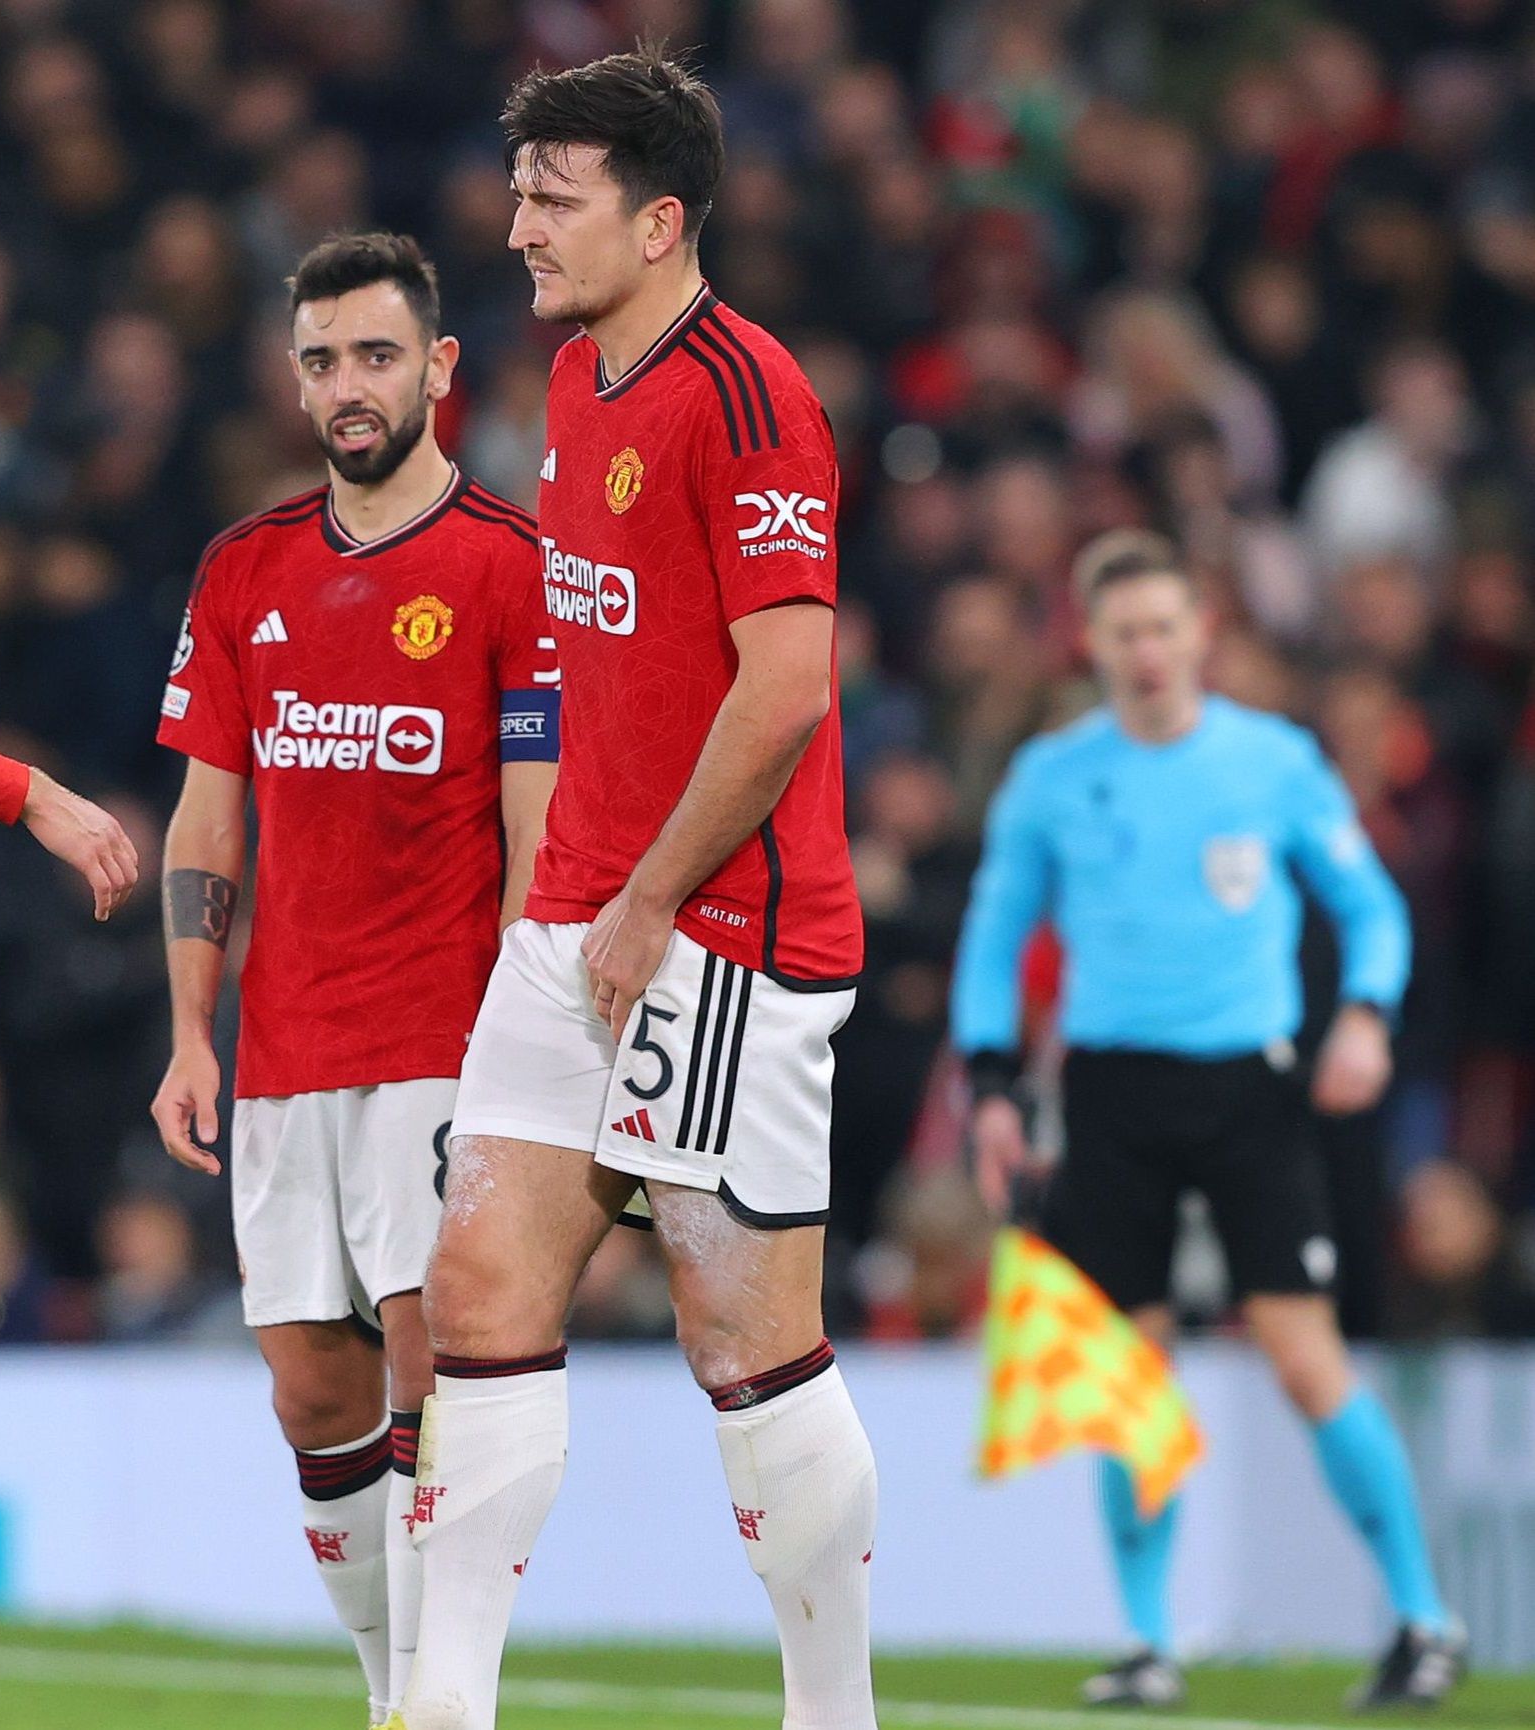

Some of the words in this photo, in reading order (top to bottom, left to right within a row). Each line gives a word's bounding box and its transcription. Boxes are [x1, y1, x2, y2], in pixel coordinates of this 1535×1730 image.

[734, 489, 827, 546] DXC
[541, 535, 594, 593] Team
[740, 538, 827, 561] TECHNOLOGY
[271, 690, 378, 736] Team
[499, 716, 546, 735] SPECT
[251, 726, 375, 771] Vewer
[698, 904, 749, 929] HEAT.RDY
[621, 1001, 680, 1101] 5
